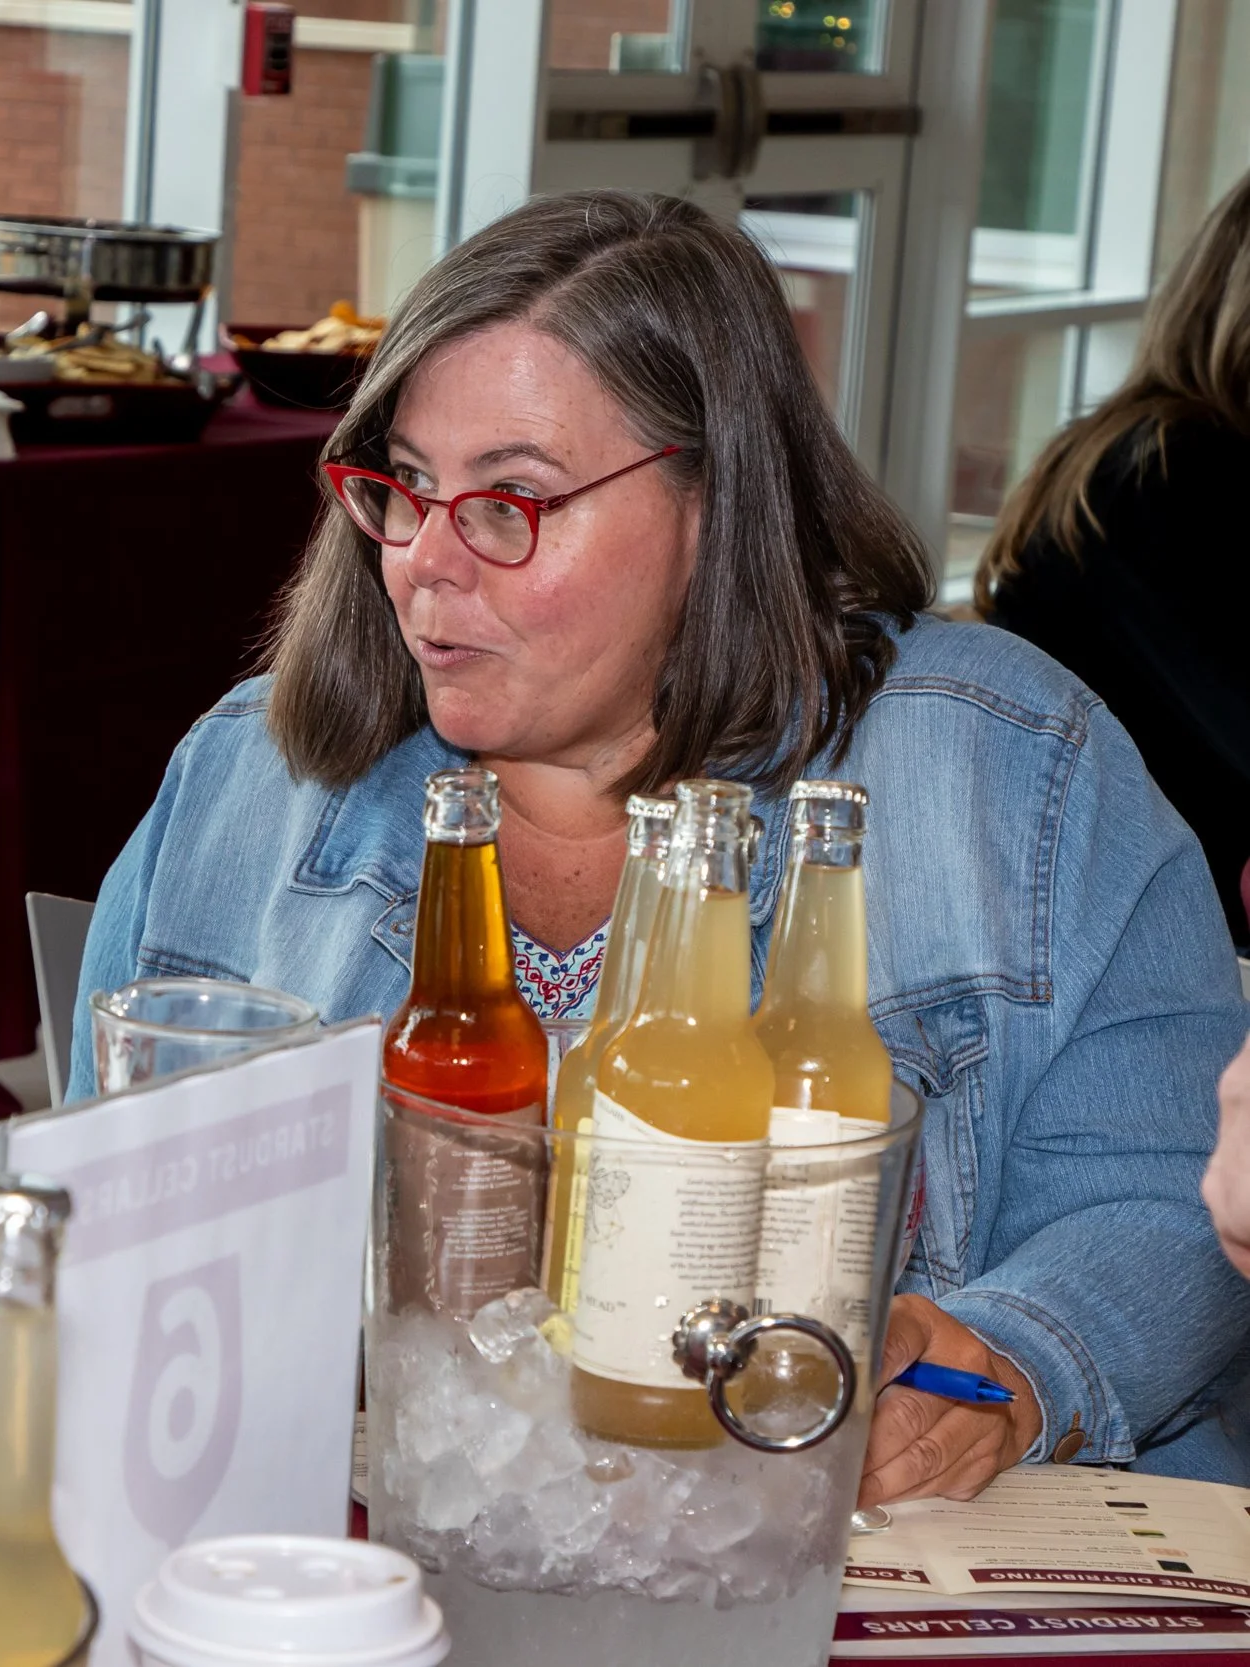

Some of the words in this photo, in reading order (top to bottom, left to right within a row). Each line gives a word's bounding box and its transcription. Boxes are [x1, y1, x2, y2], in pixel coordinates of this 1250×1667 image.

[989, 1572, 1154, 1584] DISTRIBUTING
[1159, 1578, 1249, 1596] EMPIRE
[861, 1618, 1017, 1634] CELLARS
[1028, 1617, 1205, 1629] STARDUST
